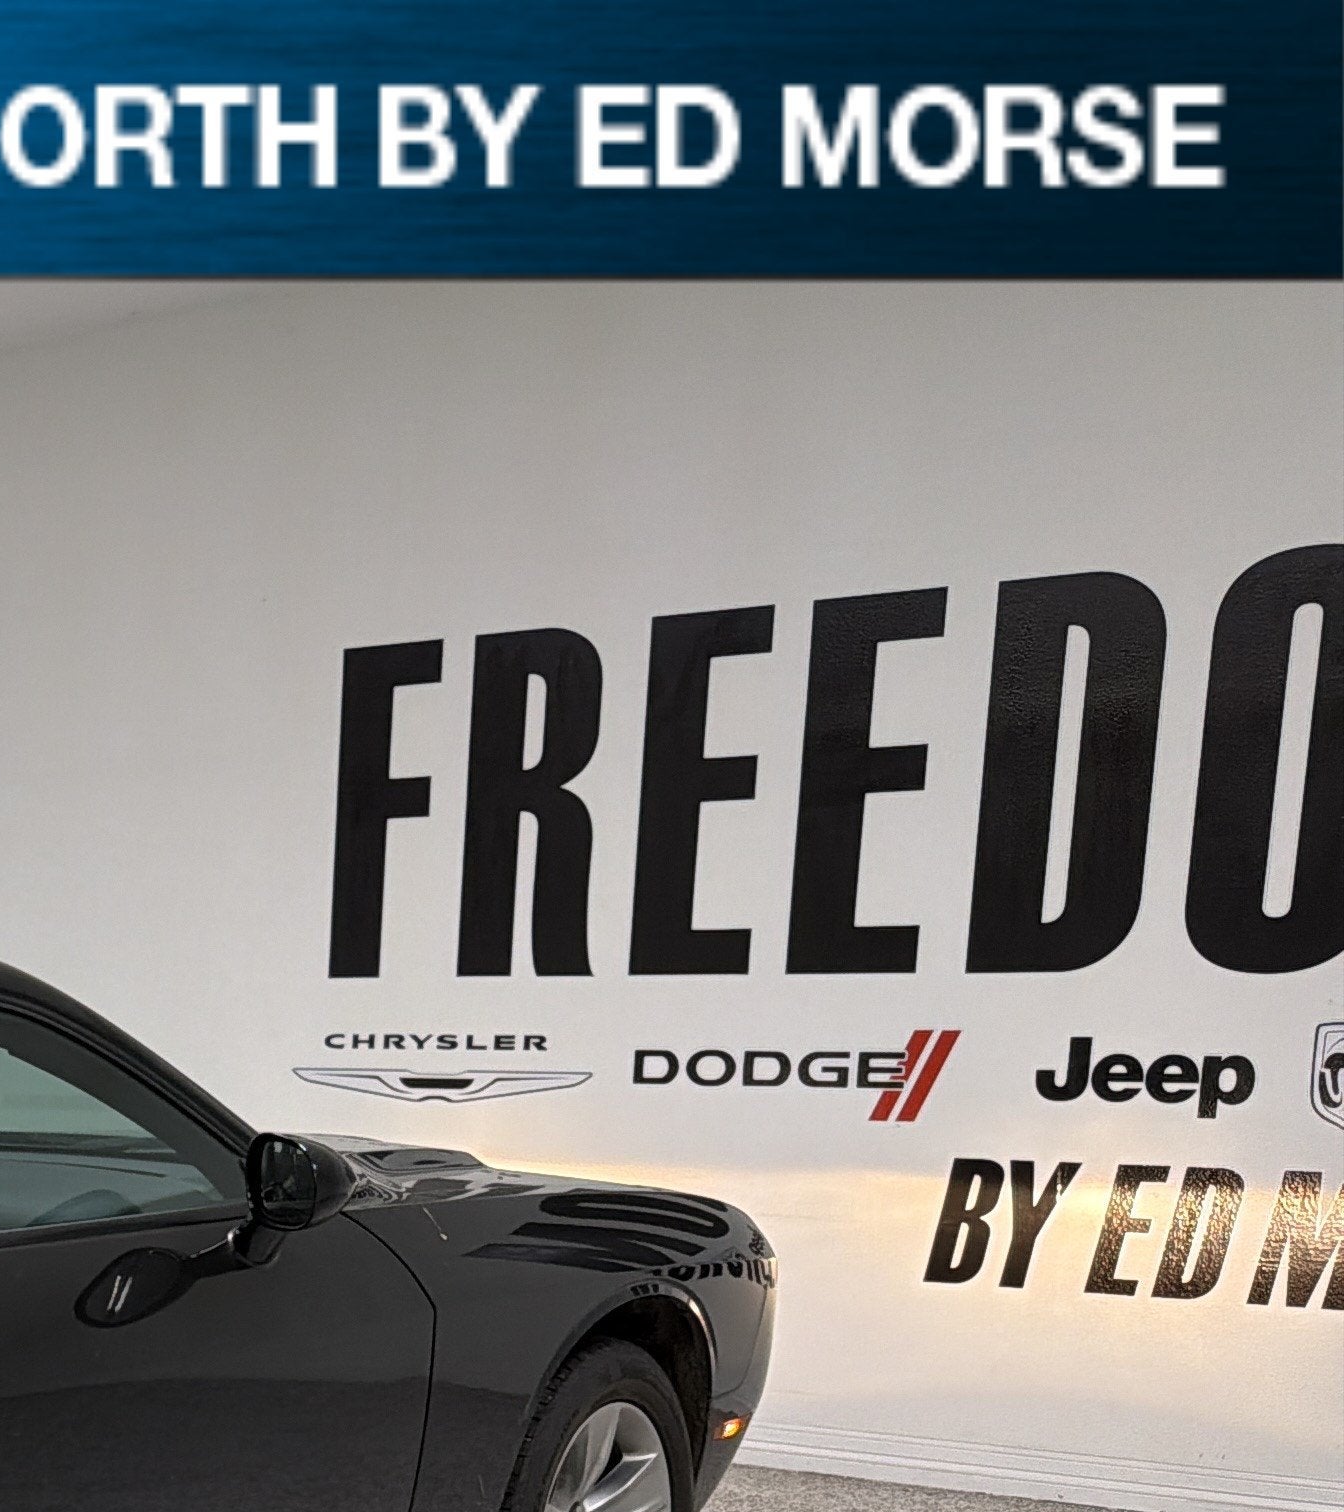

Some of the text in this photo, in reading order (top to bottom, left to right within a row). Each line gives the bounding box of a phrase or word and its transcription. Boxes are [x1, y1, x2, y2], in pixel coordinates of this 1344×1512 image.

[327, 542, 1344, 979] FREEDO
[324, 1033, 548, 1051] CHRYSLER
[632, 1049, 907, 1089] DODGE
[1035, 1036, 1256, 1120] Jeep
[922, 1157, 1083, 1289] BY
[1083, 1164, 1246, 1301] ED
